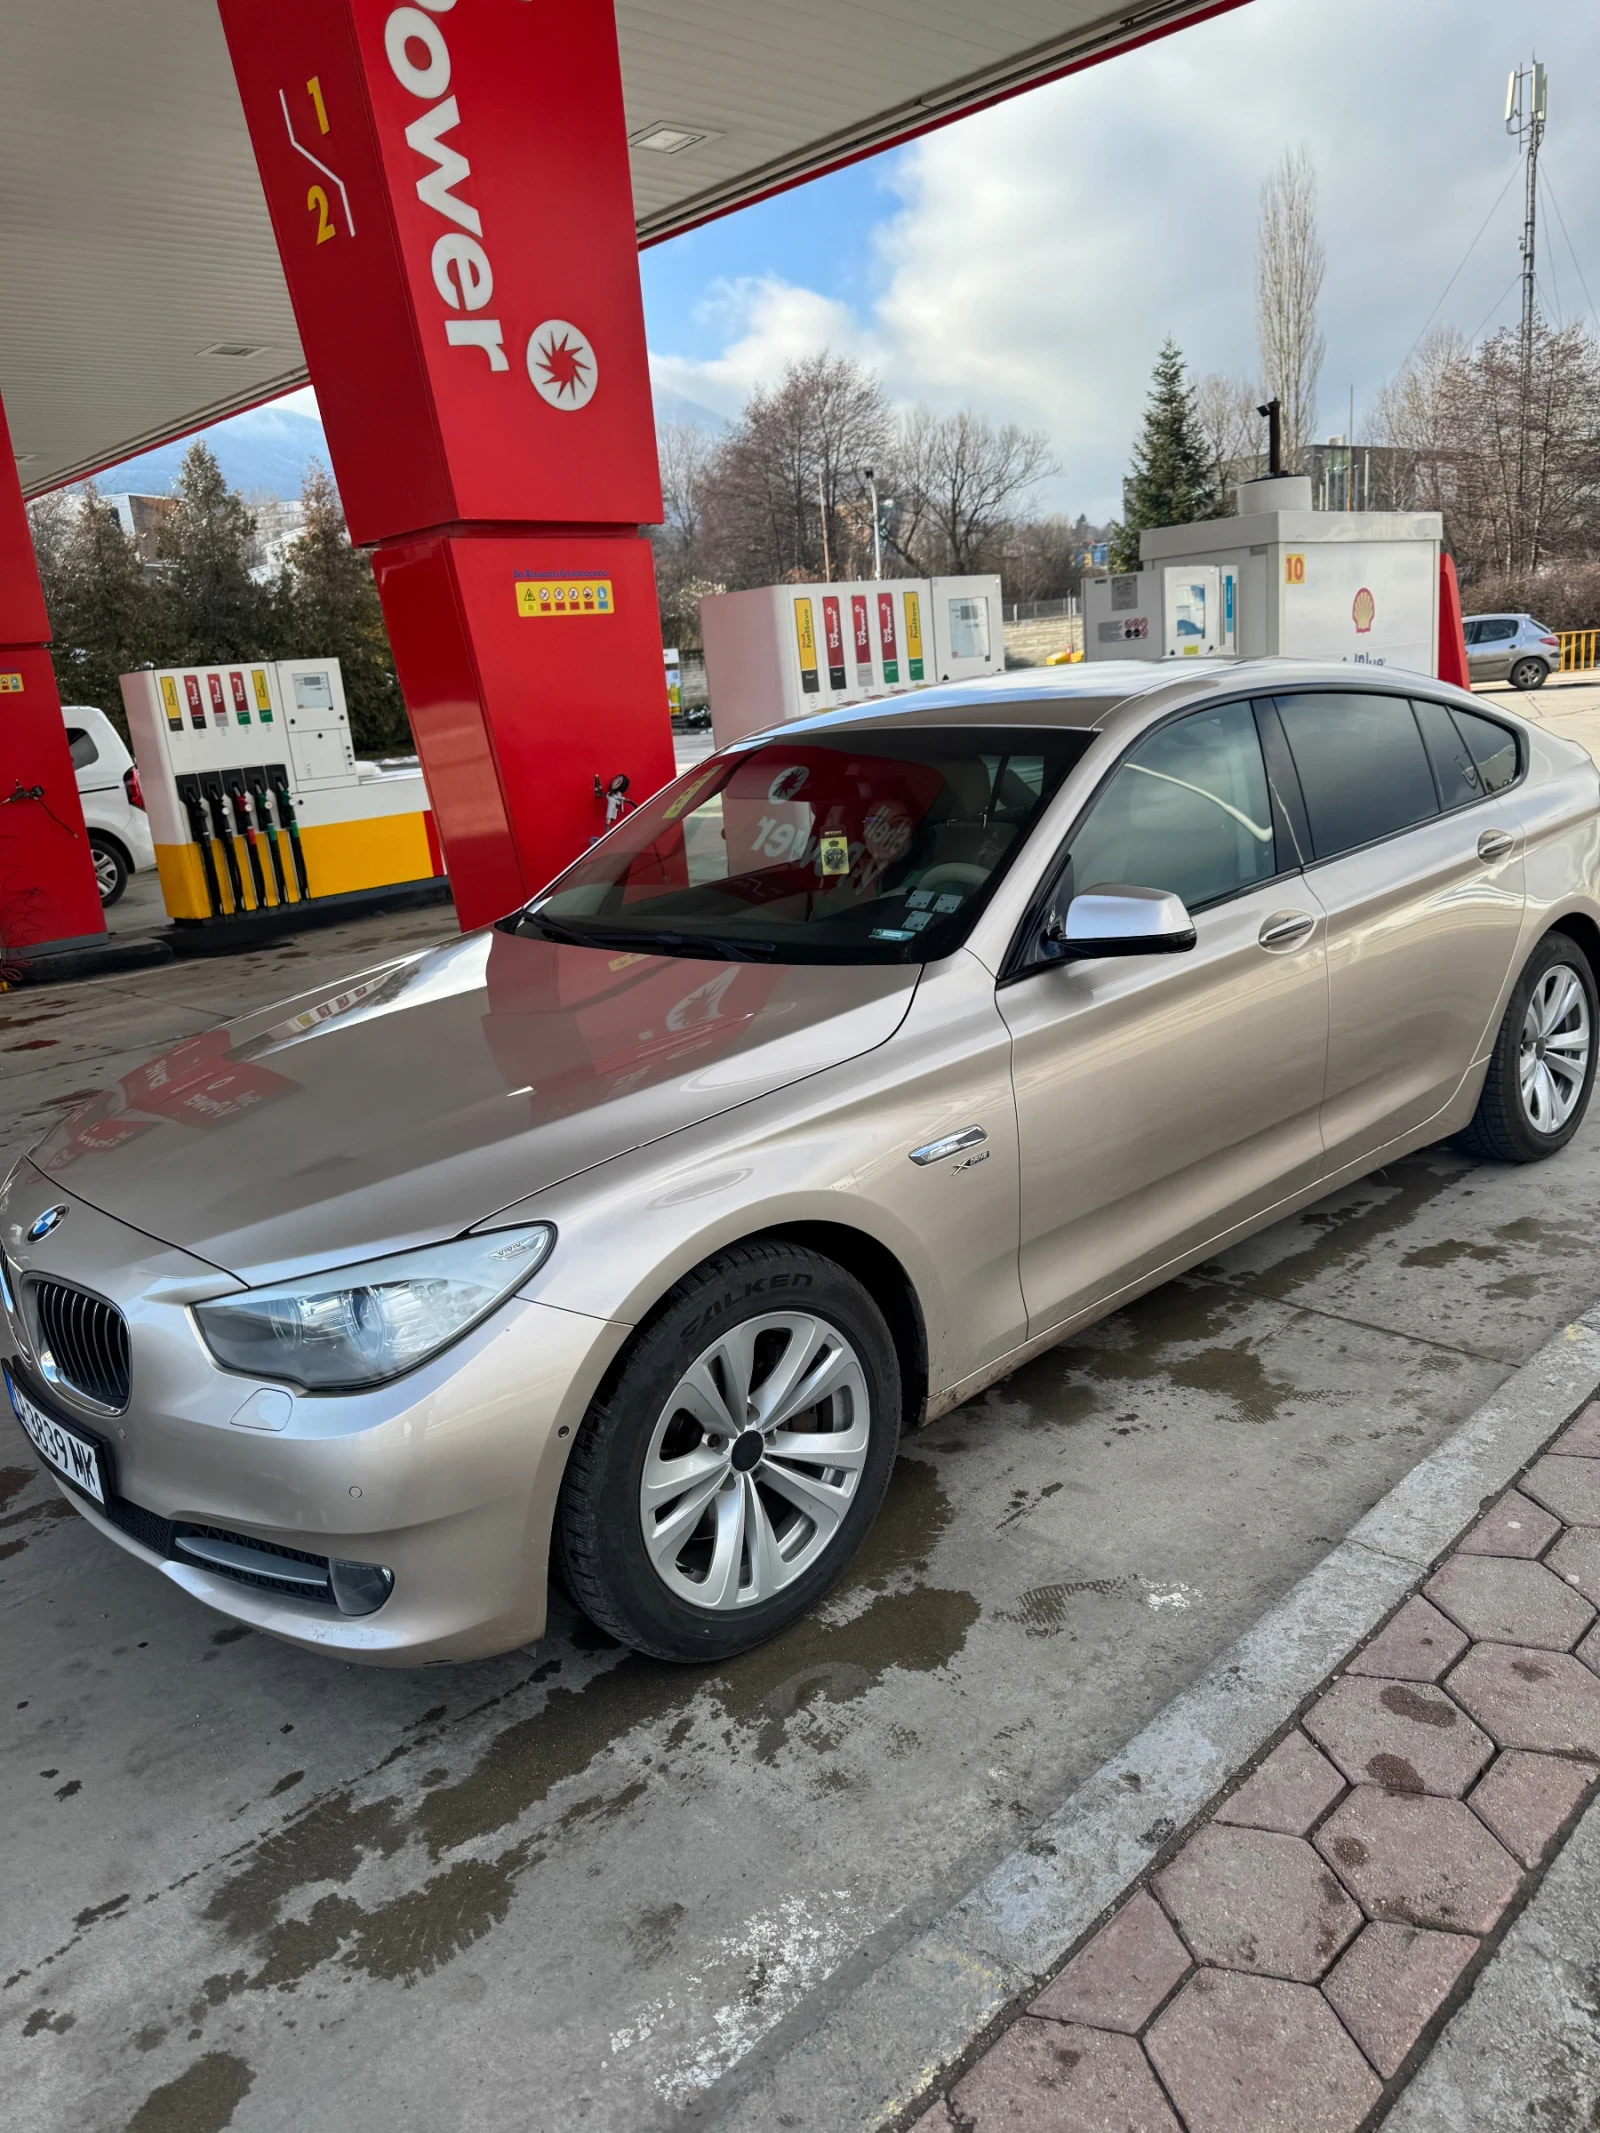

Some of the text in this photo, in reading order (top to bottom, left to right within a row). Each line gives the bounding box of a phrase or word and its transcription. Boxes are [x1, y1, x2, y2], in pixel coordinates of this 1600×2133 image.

[306, 75, 330, 135] 1
[307, 185, 336, 246] 2
[384, 0, 510, 373] ower
[1286, 556, 1304, 582] 10
